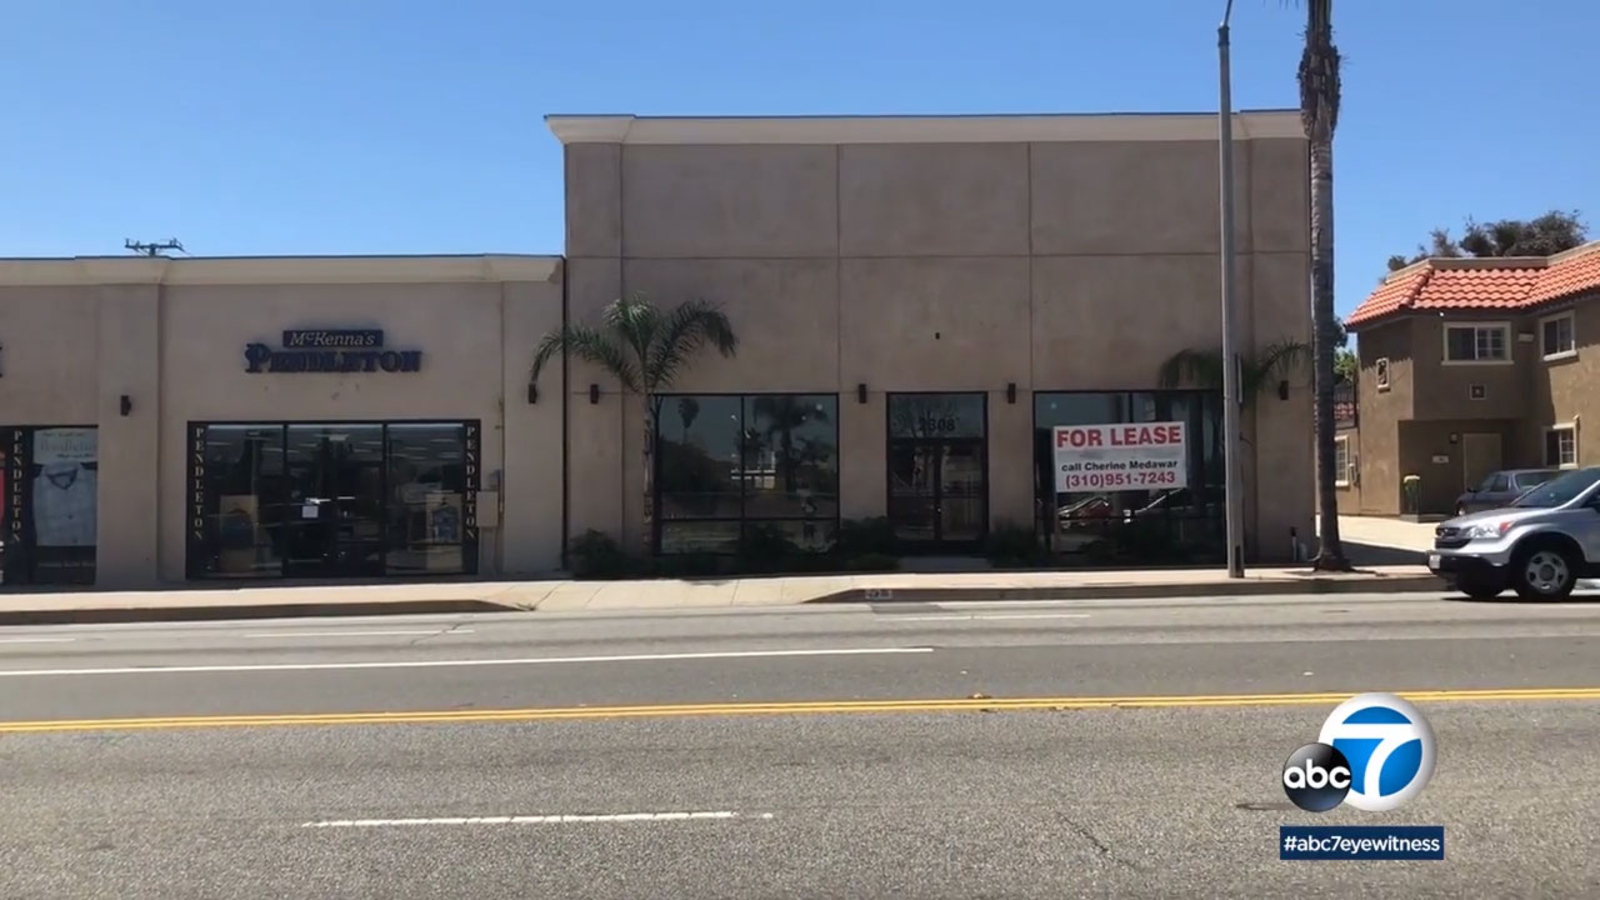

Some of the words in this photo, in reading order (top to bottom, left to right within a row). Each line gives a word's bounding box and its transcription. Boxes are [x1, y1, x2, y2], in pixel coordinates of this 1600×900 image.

[289, 331, 376, 347] McKenna's
[245, 343, 422, 373] PENDLETON
[1056, 428, 1103, 448] FOR
[1110, 425, 1182, 446] LEASE
[1061, 462, 1082, 472] call
[1084, 461, 1127, 471] Cherine
[1129, 460, 1178, 470] Medawar
[1065, 471, 1176, 489] (310)951-7243
